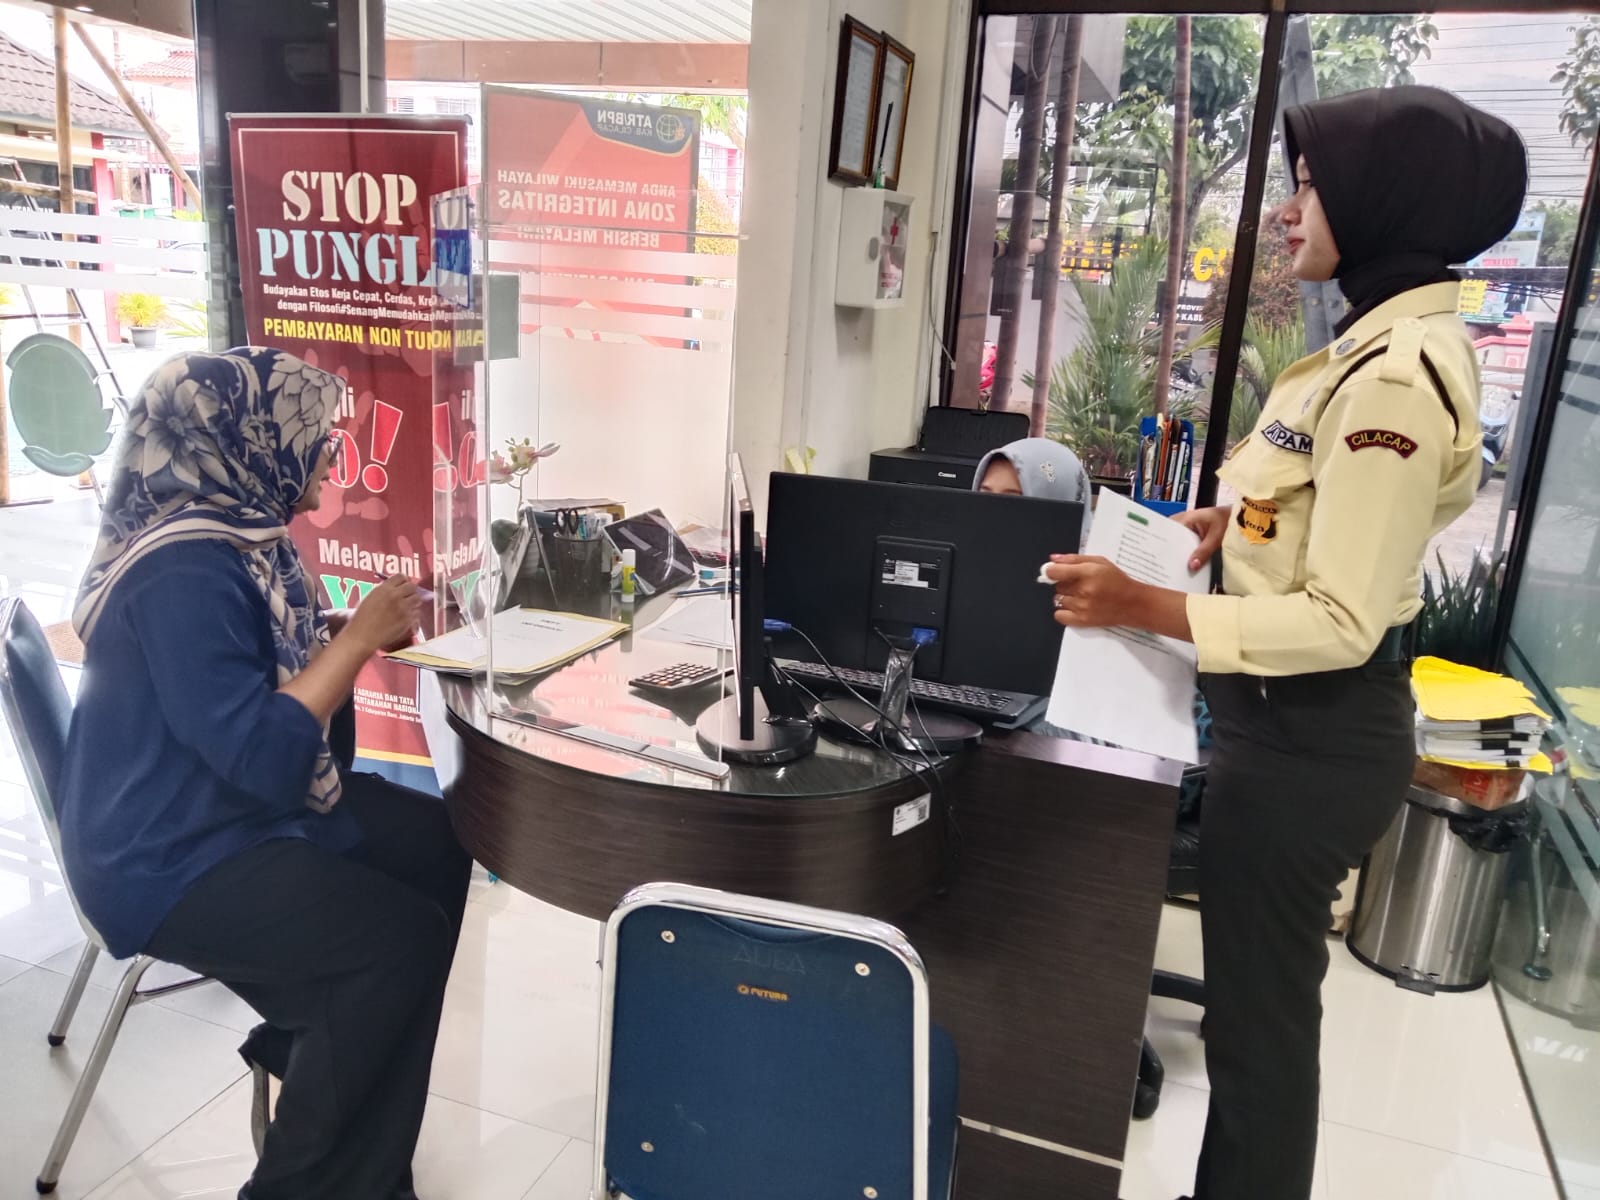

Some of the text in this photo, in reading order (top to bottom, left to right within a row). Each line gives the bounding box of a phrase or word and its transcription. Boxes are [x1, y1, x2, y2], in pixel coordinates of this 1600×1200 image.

[281, 170, 417, 226] STOP
[257, 227, 437, 288] PUNGL
[263, 283, 308, 298] Budayakan
[310, 286, 329, 298] Etos
[331, 288, 350, 301] Kerja
[352, 290, 383, 303] Cepat,
[384, 292, 416, 307] Cerdas,
[277, 300, 307, 313] dengan
[263, 317, 363, 344] PEMBAYARAN
[369, 326, 401, 347] NON
[1351, 430, 1412, 453] CILACAP
[318, 538, 420, 579] Melayani
[385, 693, 397, 702] DAN
[399, 696, 414, 705] TATA
[750, 987, 789, 1001] FUTURA
